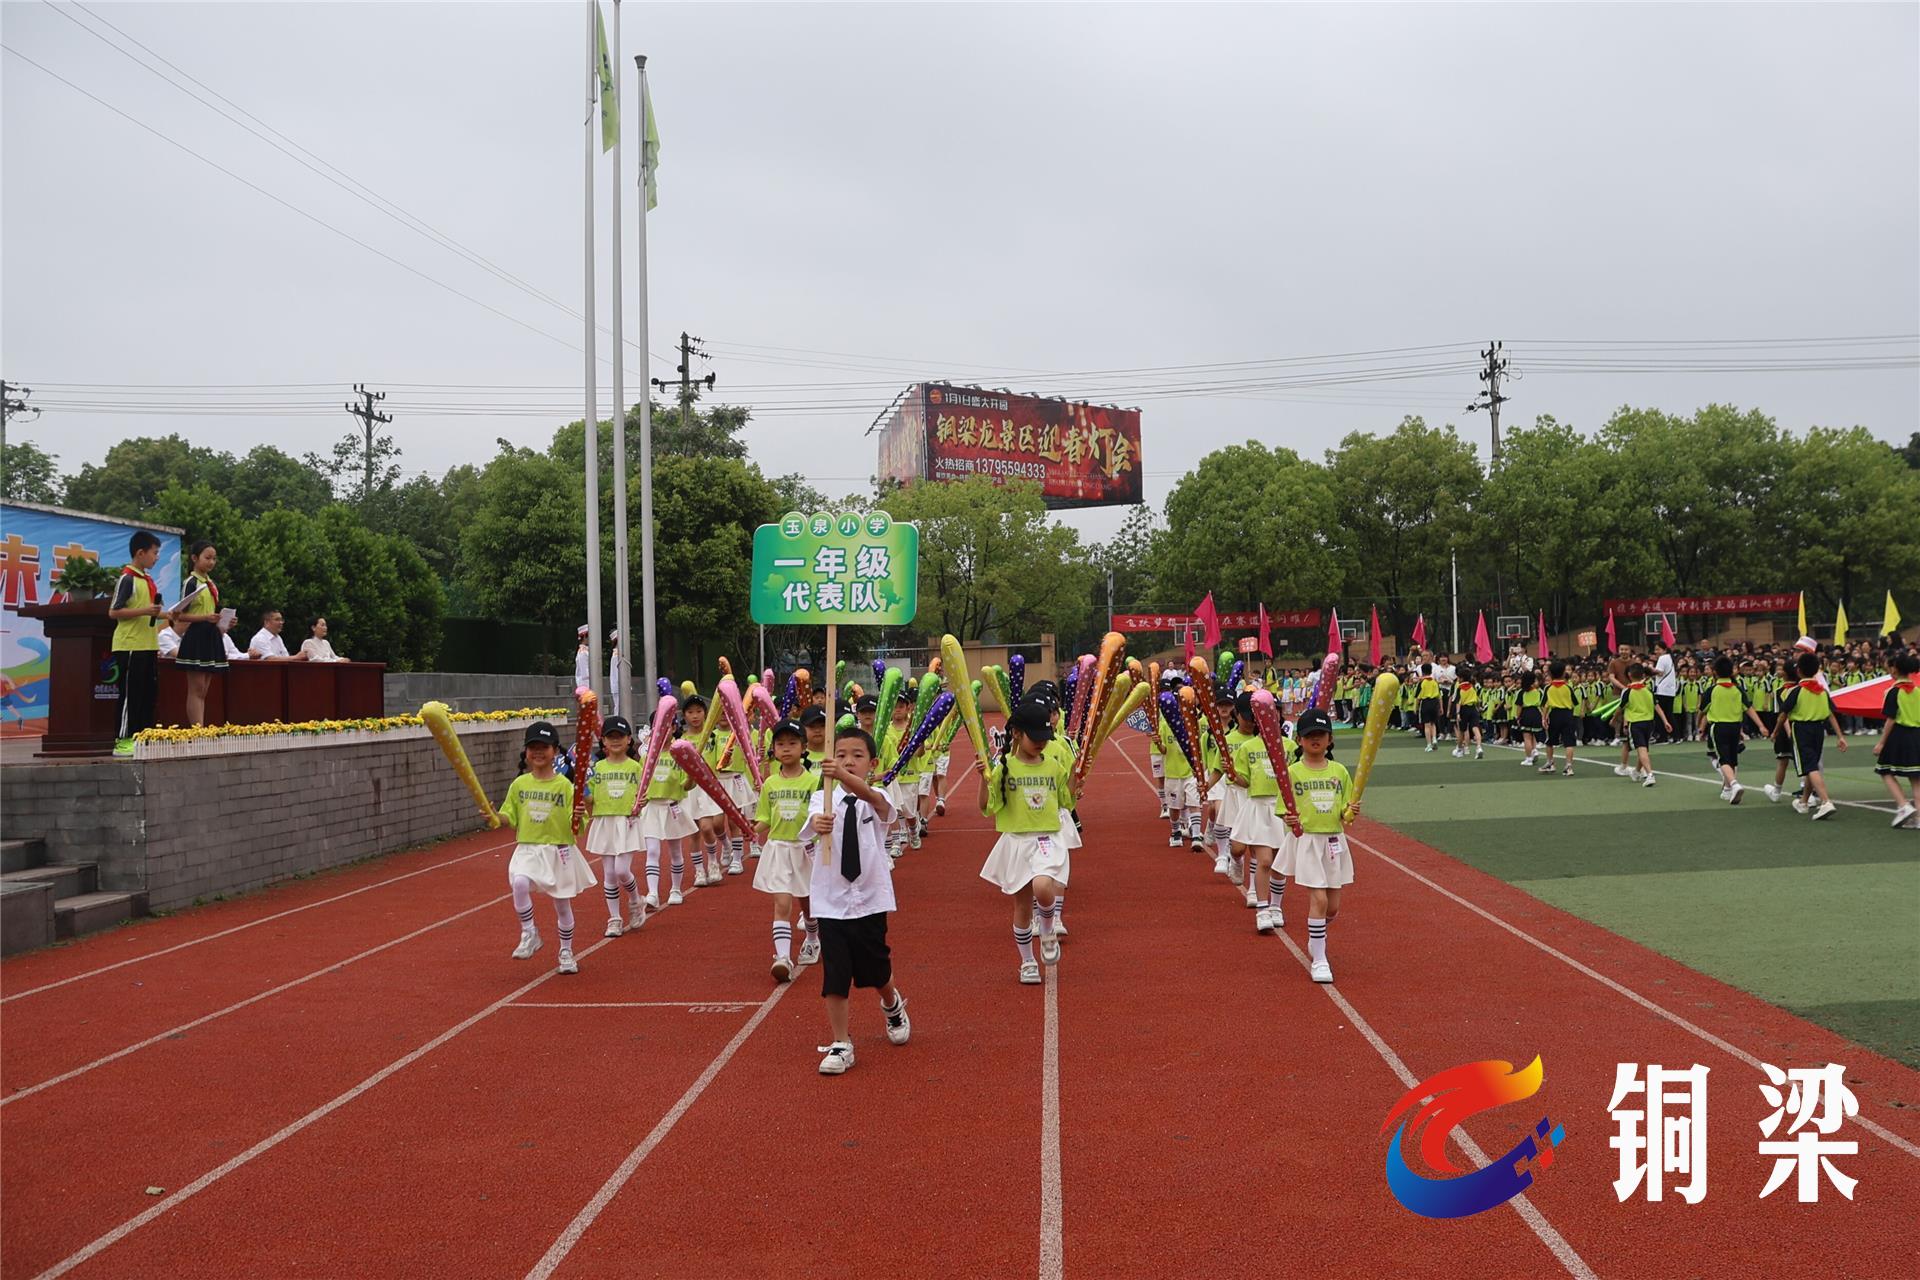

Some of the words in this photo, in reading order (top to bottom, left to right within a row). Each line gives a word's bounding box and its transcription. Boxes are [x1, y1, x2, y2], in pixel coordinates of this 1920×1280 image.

[936, 413, 1132, 479] 铜梁龙景区迎春灯会
[935, 457, 974, 471] 火热招商
[975, 458, 1046, 479] 13795594333
[785, 518, 886, 535] 玉泉小学
[774, 546, 890, 579] 一年级
[782, 582, 880, 612] 代表队
